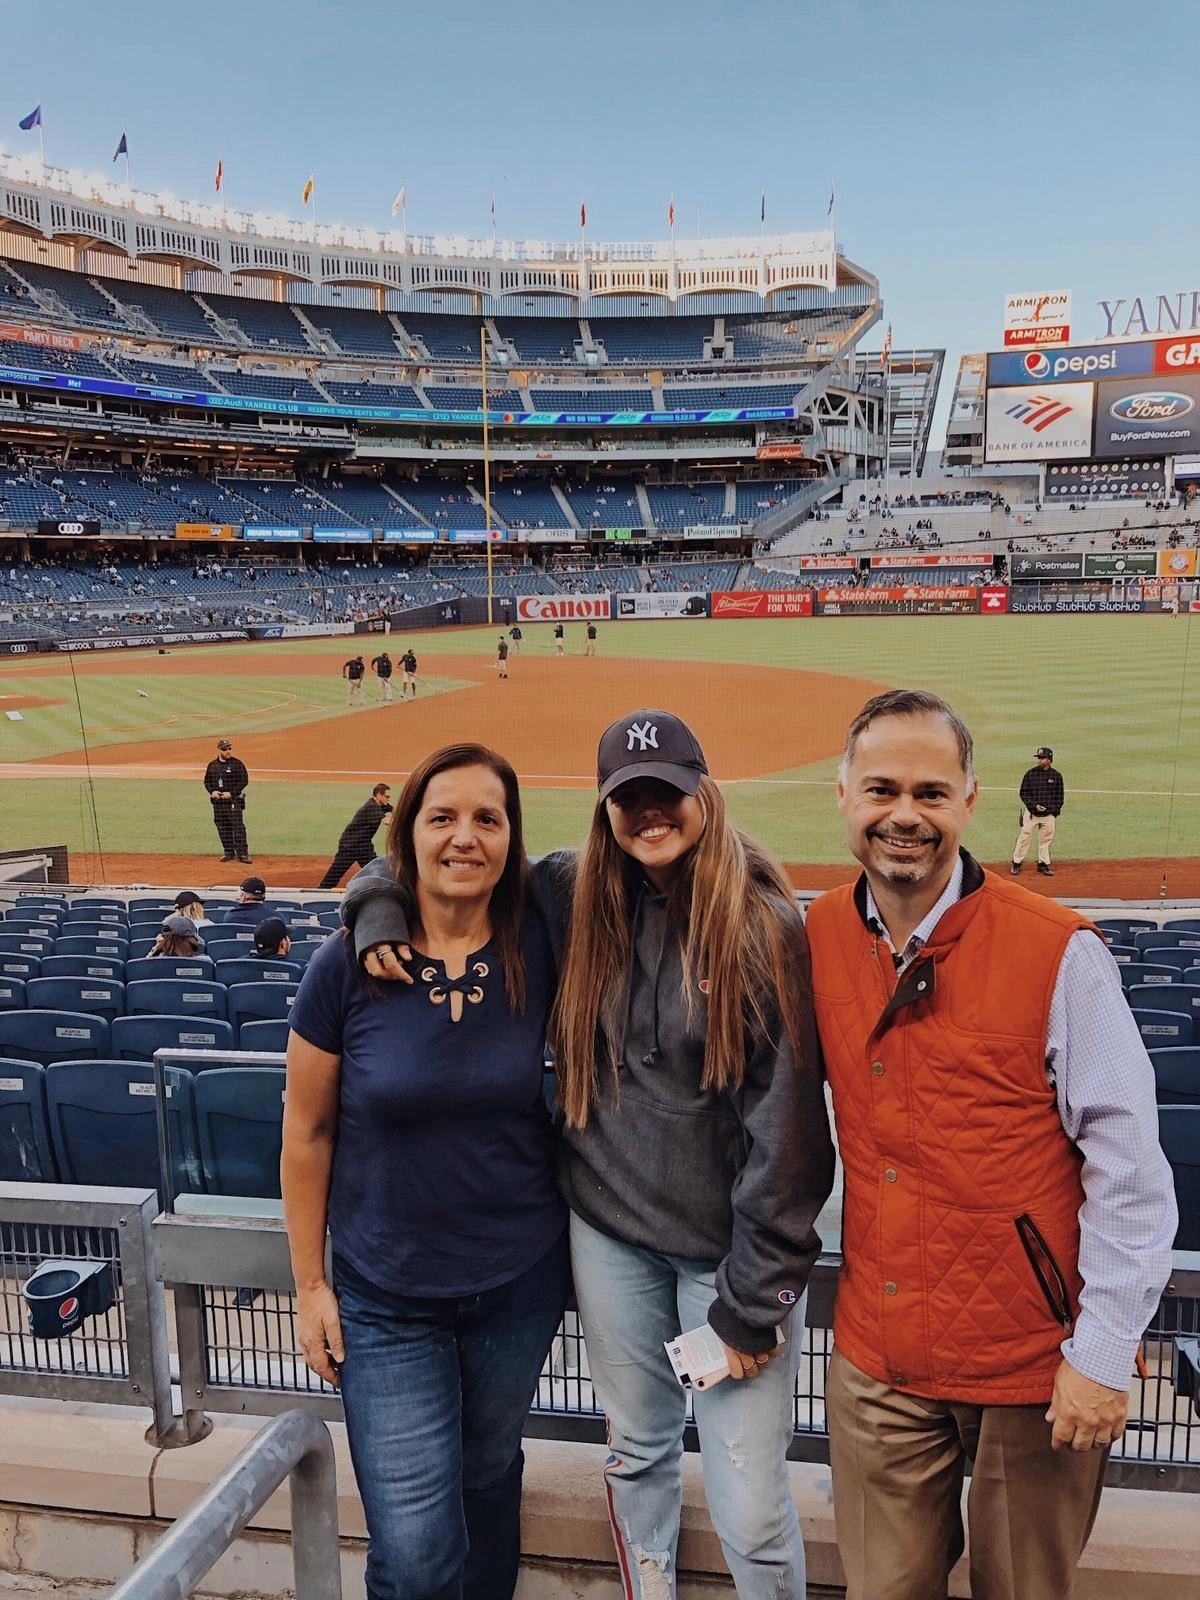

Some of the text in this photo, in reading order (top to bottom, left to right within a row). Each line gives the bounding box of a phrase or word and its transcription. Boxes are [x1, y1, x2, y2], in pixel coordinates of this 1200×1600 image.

[1008, 295, 1068, 308] ARMITRON
[23, 330, 74, 348] PARTY DECK
[1009, 328, 1064, 340] ARMITRON
[1054, 350, 1118, 376] pepsi
[224, 398, 243, 407] Audi
[244, 401, 277, 410] YANKEES
[278, 404, 299, 412] CLUB
[308, 406, 335, 414] RESERVE
[336, 407, 353, 416] YOUR
[354, 408, 373, 417] SEATS
[373, 409, 391, 417] NOW!
[433, 413, 450, 421] (212)
[451, 413, 483, 421] YANKEES
[1126, 396, 1176, 418] Ford
[1110, 429, 1190, 442] BuyFordNow.com
[988, 439, 1088, 451] BANK OF AMERICA
[687, 526, 738, 537] Poland Spring
[1035, 561, 1080, 570] Postmates
[767, 593, 810, 602] THIS BUD'S
[518, 597, 609, 619] Canon
[767, 604, 802, 613] FOR YOU.
[1012, 600, 1140, 612] StubHub StubHub StubHub
[264, 629, 281, 637] ACC
[626, 720, 660, 751] NY
